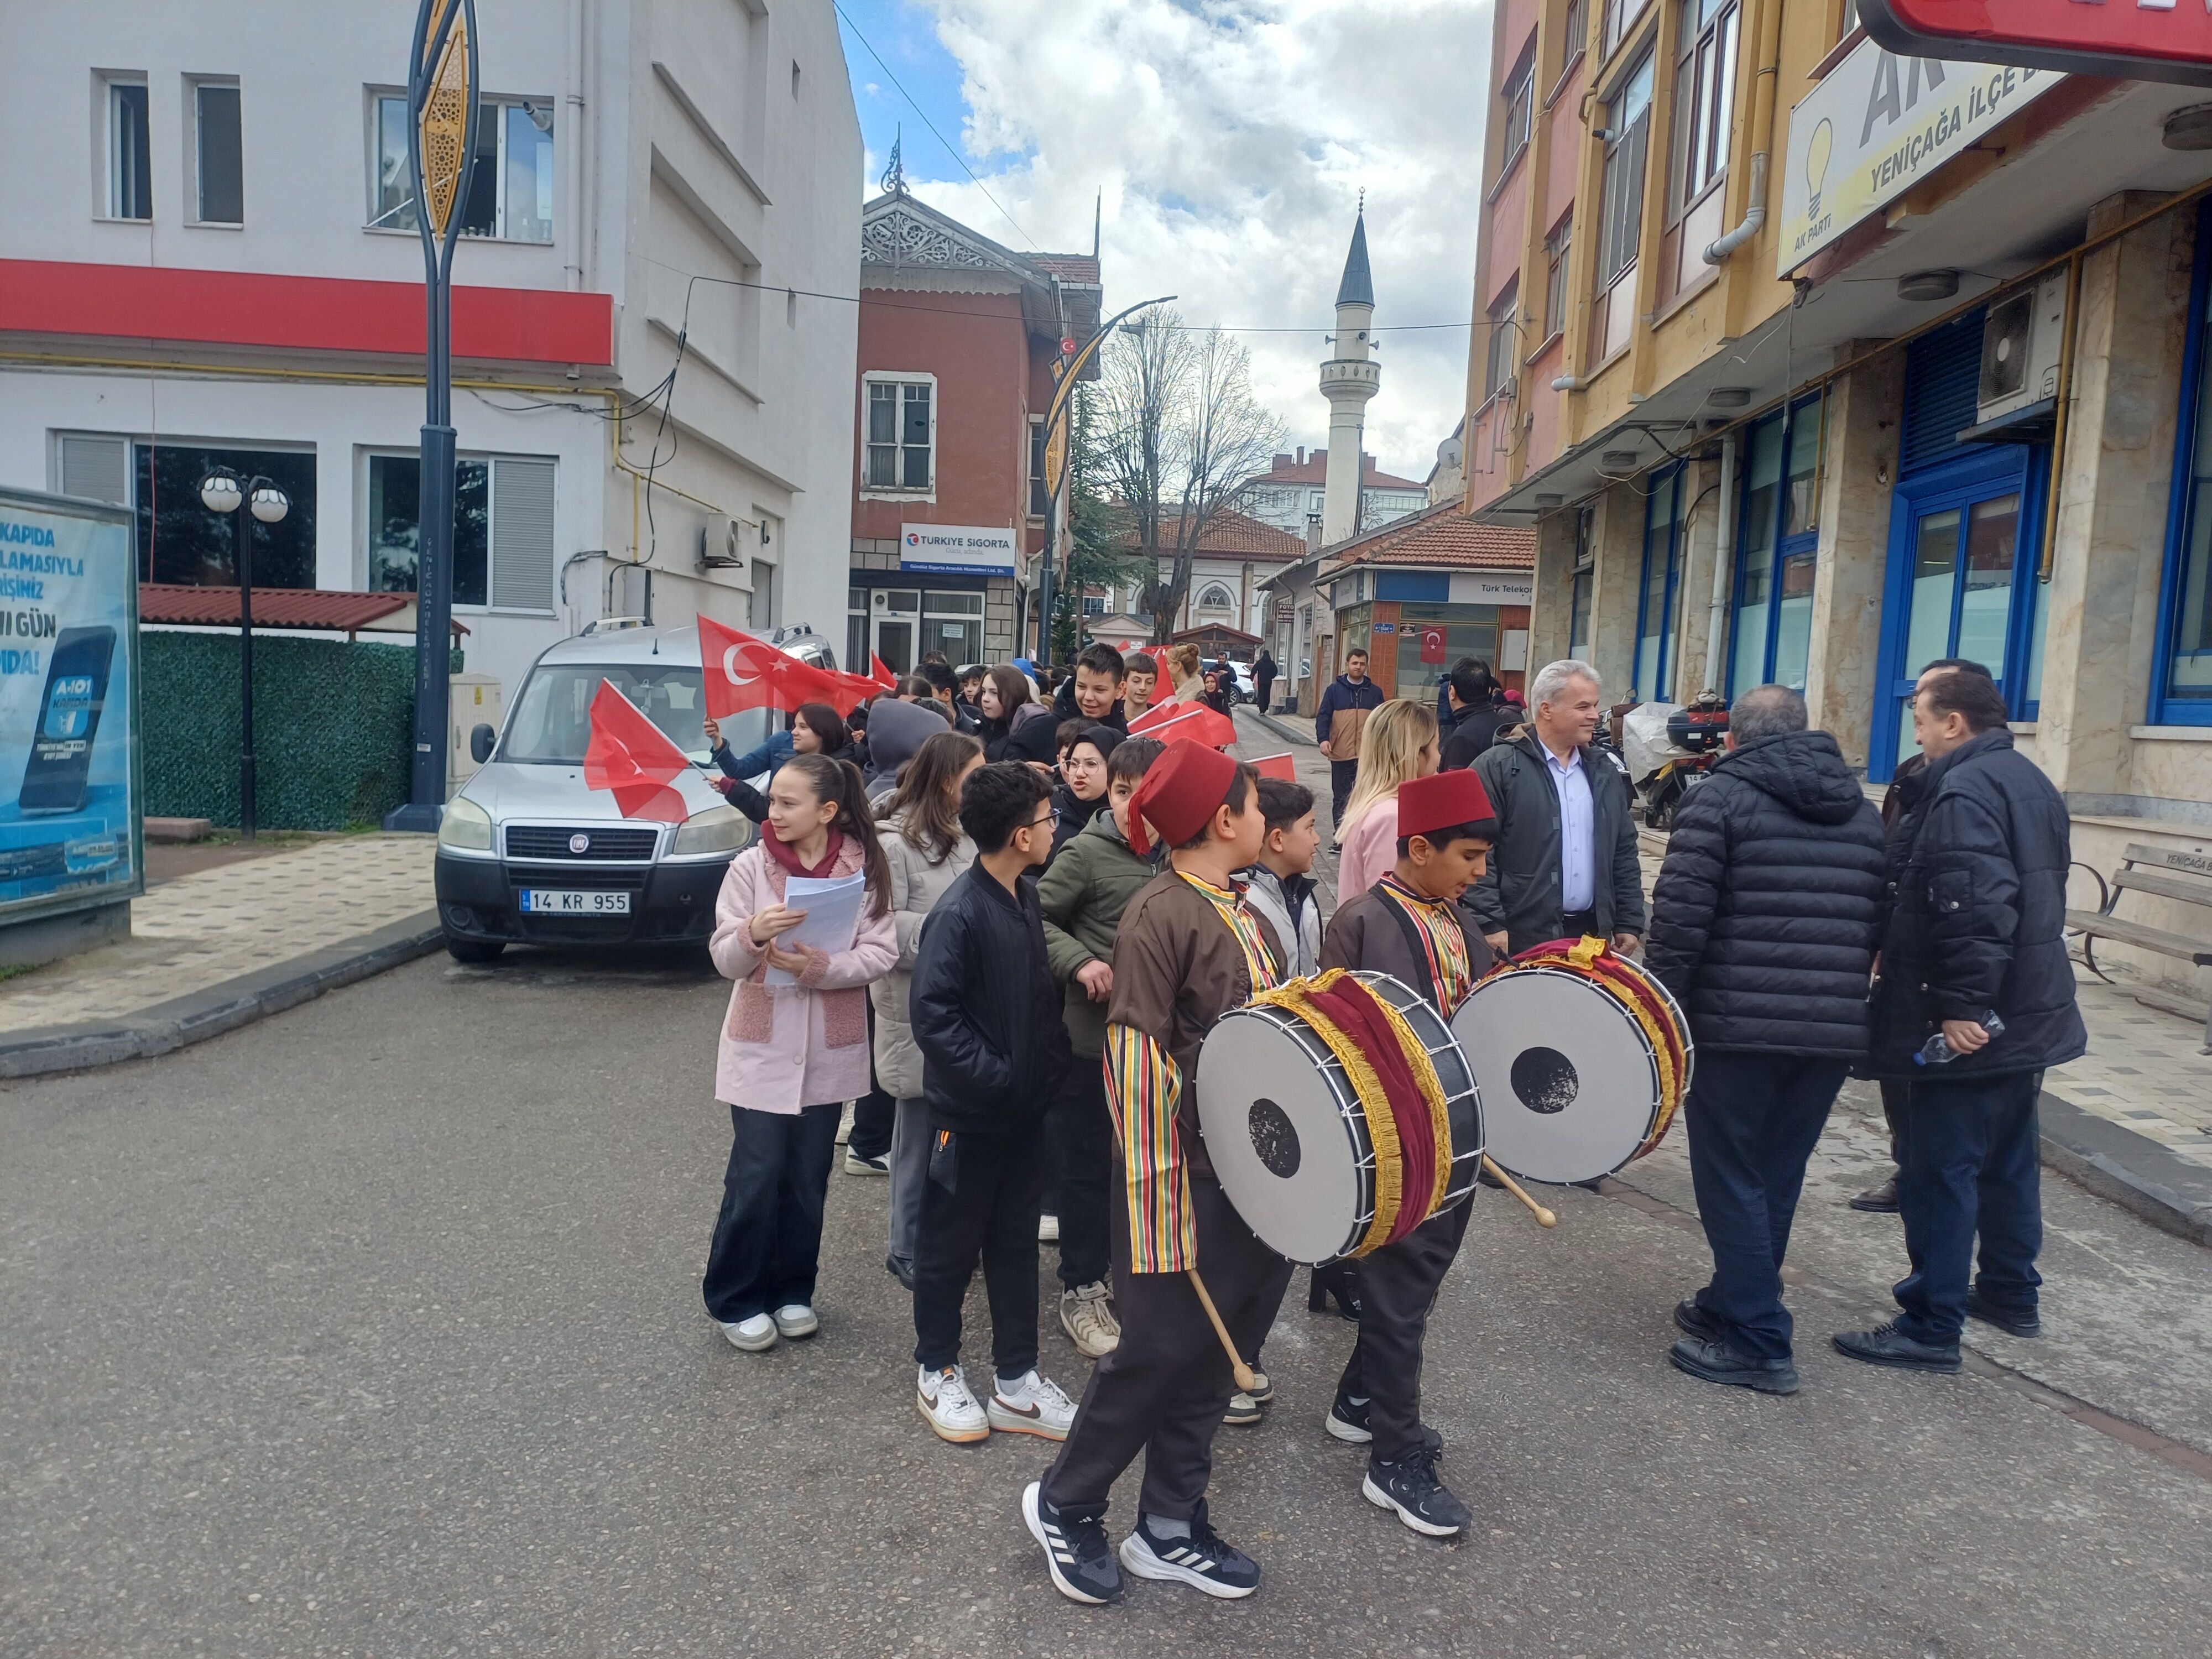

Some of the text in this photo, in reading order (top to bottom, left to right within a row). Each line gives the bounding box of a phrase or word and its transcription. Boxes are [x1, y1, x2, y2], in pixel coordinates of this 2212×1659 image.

[1871, 66, 2016, 193] YENİÇAĞA İLÇE
[1794, 212, 1831, 252] AK PARTİ
[0, 522, 55, 547] KAPIDA
[1481, 584, 1500, 592] Türk
[16, 607, 56, 638] GÜN
[534, 894, 626, 910] 14 KR 955
